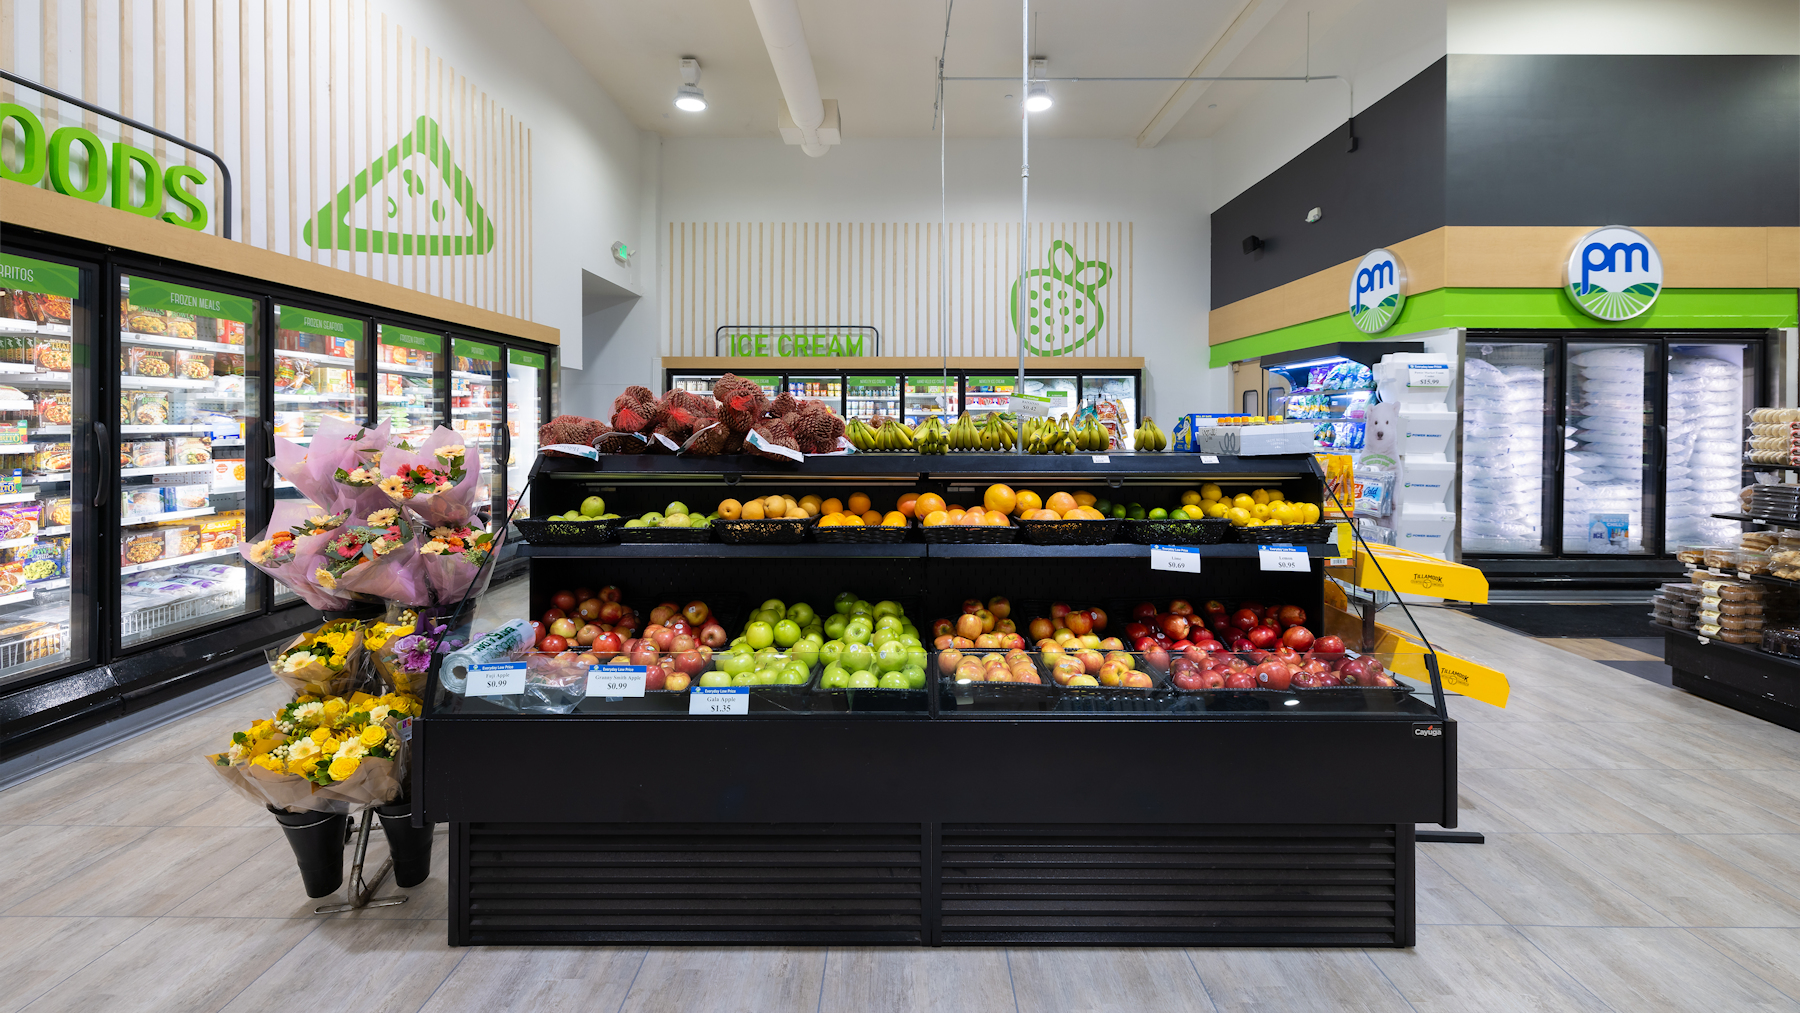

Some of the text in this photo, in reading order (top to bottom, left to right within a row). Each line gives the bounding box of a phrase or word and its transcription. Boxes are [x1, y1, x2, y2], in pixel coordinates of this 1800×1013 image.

[0, 103, 208, 231] OODS
[1580, 242, 1649, 295] pm
[1356, 260, 1394, 315] pm
[170, 292, 220, 311] FROZEN MEALS
[304, 316, 344, 332] FROZEN SEAFOOD
[730, 334, 864, 357] ICE CREAM
[1364, 486, 1378, 497] Cold
[1414, 574, 1442, 584] TILLAMOOK
[1441, 668, 1469, 682] TILLAMOOK
[486, 680, 507, 688] $0.99
[1414, 728, 1442, 737] Cayuga
